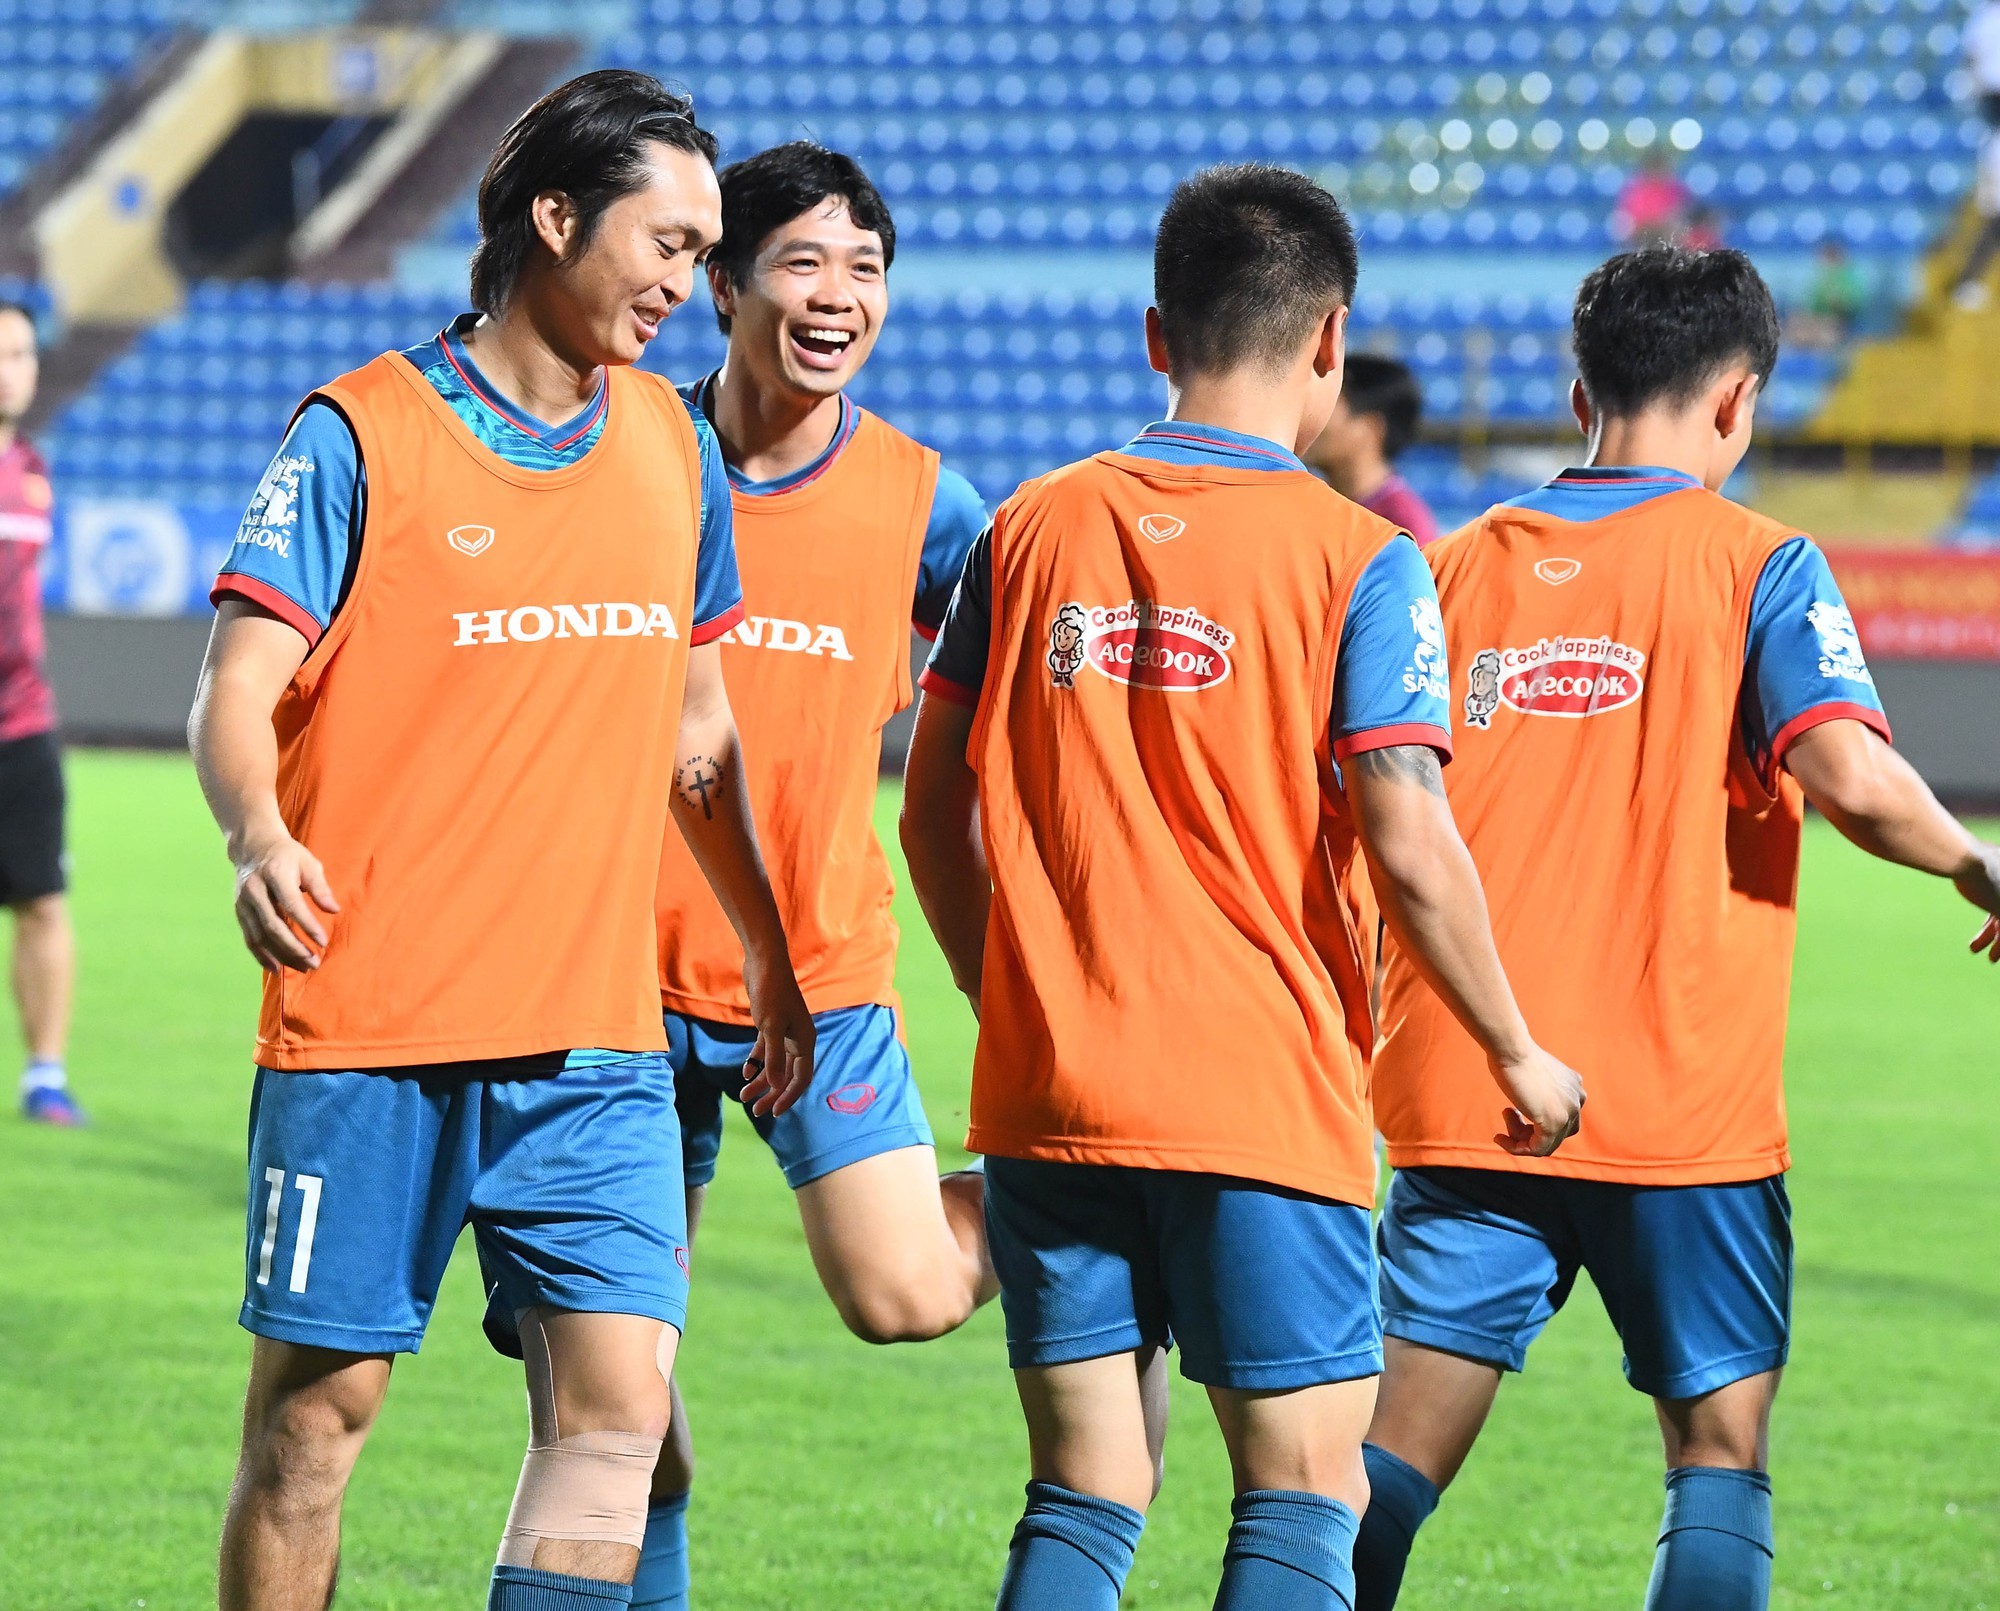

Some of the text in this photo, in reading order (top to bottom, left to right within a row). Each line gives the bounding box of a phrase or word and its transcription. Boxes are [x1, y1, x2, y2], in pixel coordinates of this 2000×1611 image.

[452, 602, 679, 647] HONDA
[1091, 603, 1140, 627] Cook
[719, 616, 854, 661] NDA
[1504, 643, 1550, 667] Cook
[256, 1166, 323, 1294] 11
